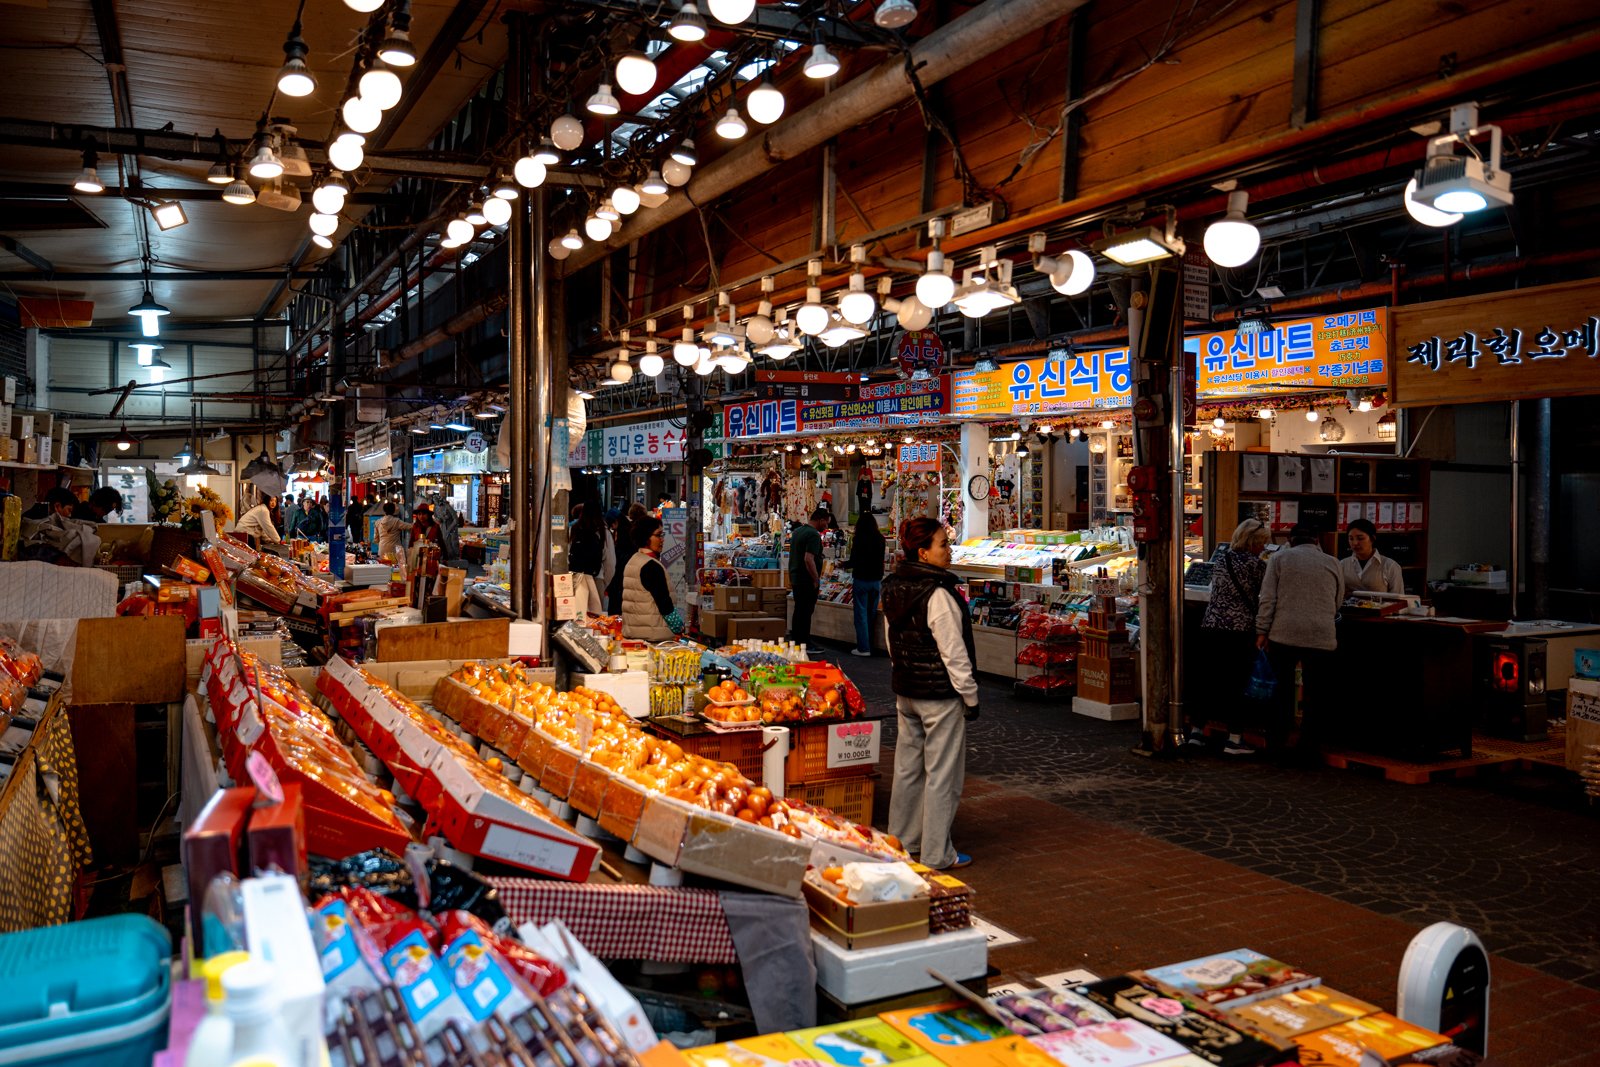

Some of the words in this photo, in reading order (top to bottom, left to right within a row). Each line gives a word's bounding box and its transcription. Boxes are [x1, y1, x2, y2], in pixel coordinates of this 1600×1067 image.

[1324, 310, 1376, 329] 오메기떡
[1204, 322, 1315, 372] 유신마트
[1329, 336, 1370, 352] 초코렛
[1009, 350, 1132, 400] 유신식당
[1213, 372, 1242, 384] 유신식당
[1245, 370, 1268, 380] 이용시
[1318, 360, 1384, 378] 각종기념품
[808, 404, 834, 420] 유신횟집
[840, 401, 874, 416] 유신회수산
[876, 398, 898, 412] 이용시
[900, 394, 931, 411] 할인혜택
[728, 399, 798, 438] 유신마트
[470, 438, 482, 452] 떡
